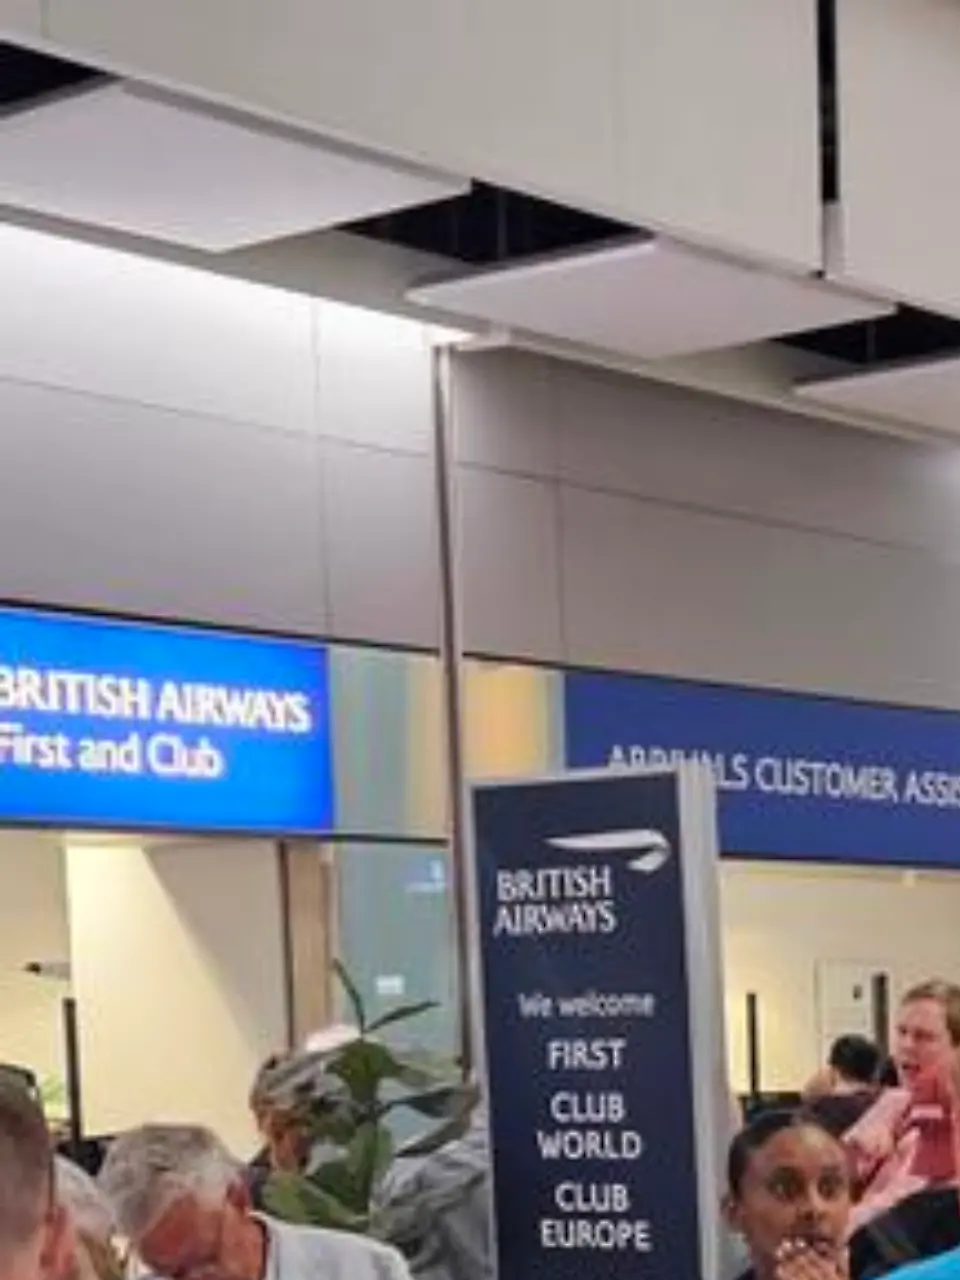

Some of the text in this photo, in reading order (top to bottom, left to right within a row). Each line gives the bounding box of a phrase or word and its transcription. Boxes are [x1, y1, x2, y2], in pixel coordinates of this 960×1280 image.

[0, 663, 313, 732] BRITISH AIRWAYS
[0, 721, 224, 778] First and Club
[754, 757, 897, 802] CUSTOMER
[496, 865, 613, 901] BRITISH
[493, 899, 618, 936] AIRWAYS
[517, 989, 656, 1019] We welcome
[547, 1037, 626, 1071] FIRST
[550, 1090, 626, 1123] CLUB
[536, 1129, 643, 1160] WORLD
[554, 1180, 630, 1213] CLUB
[540, 1218, 652, 1251] EUROPE
